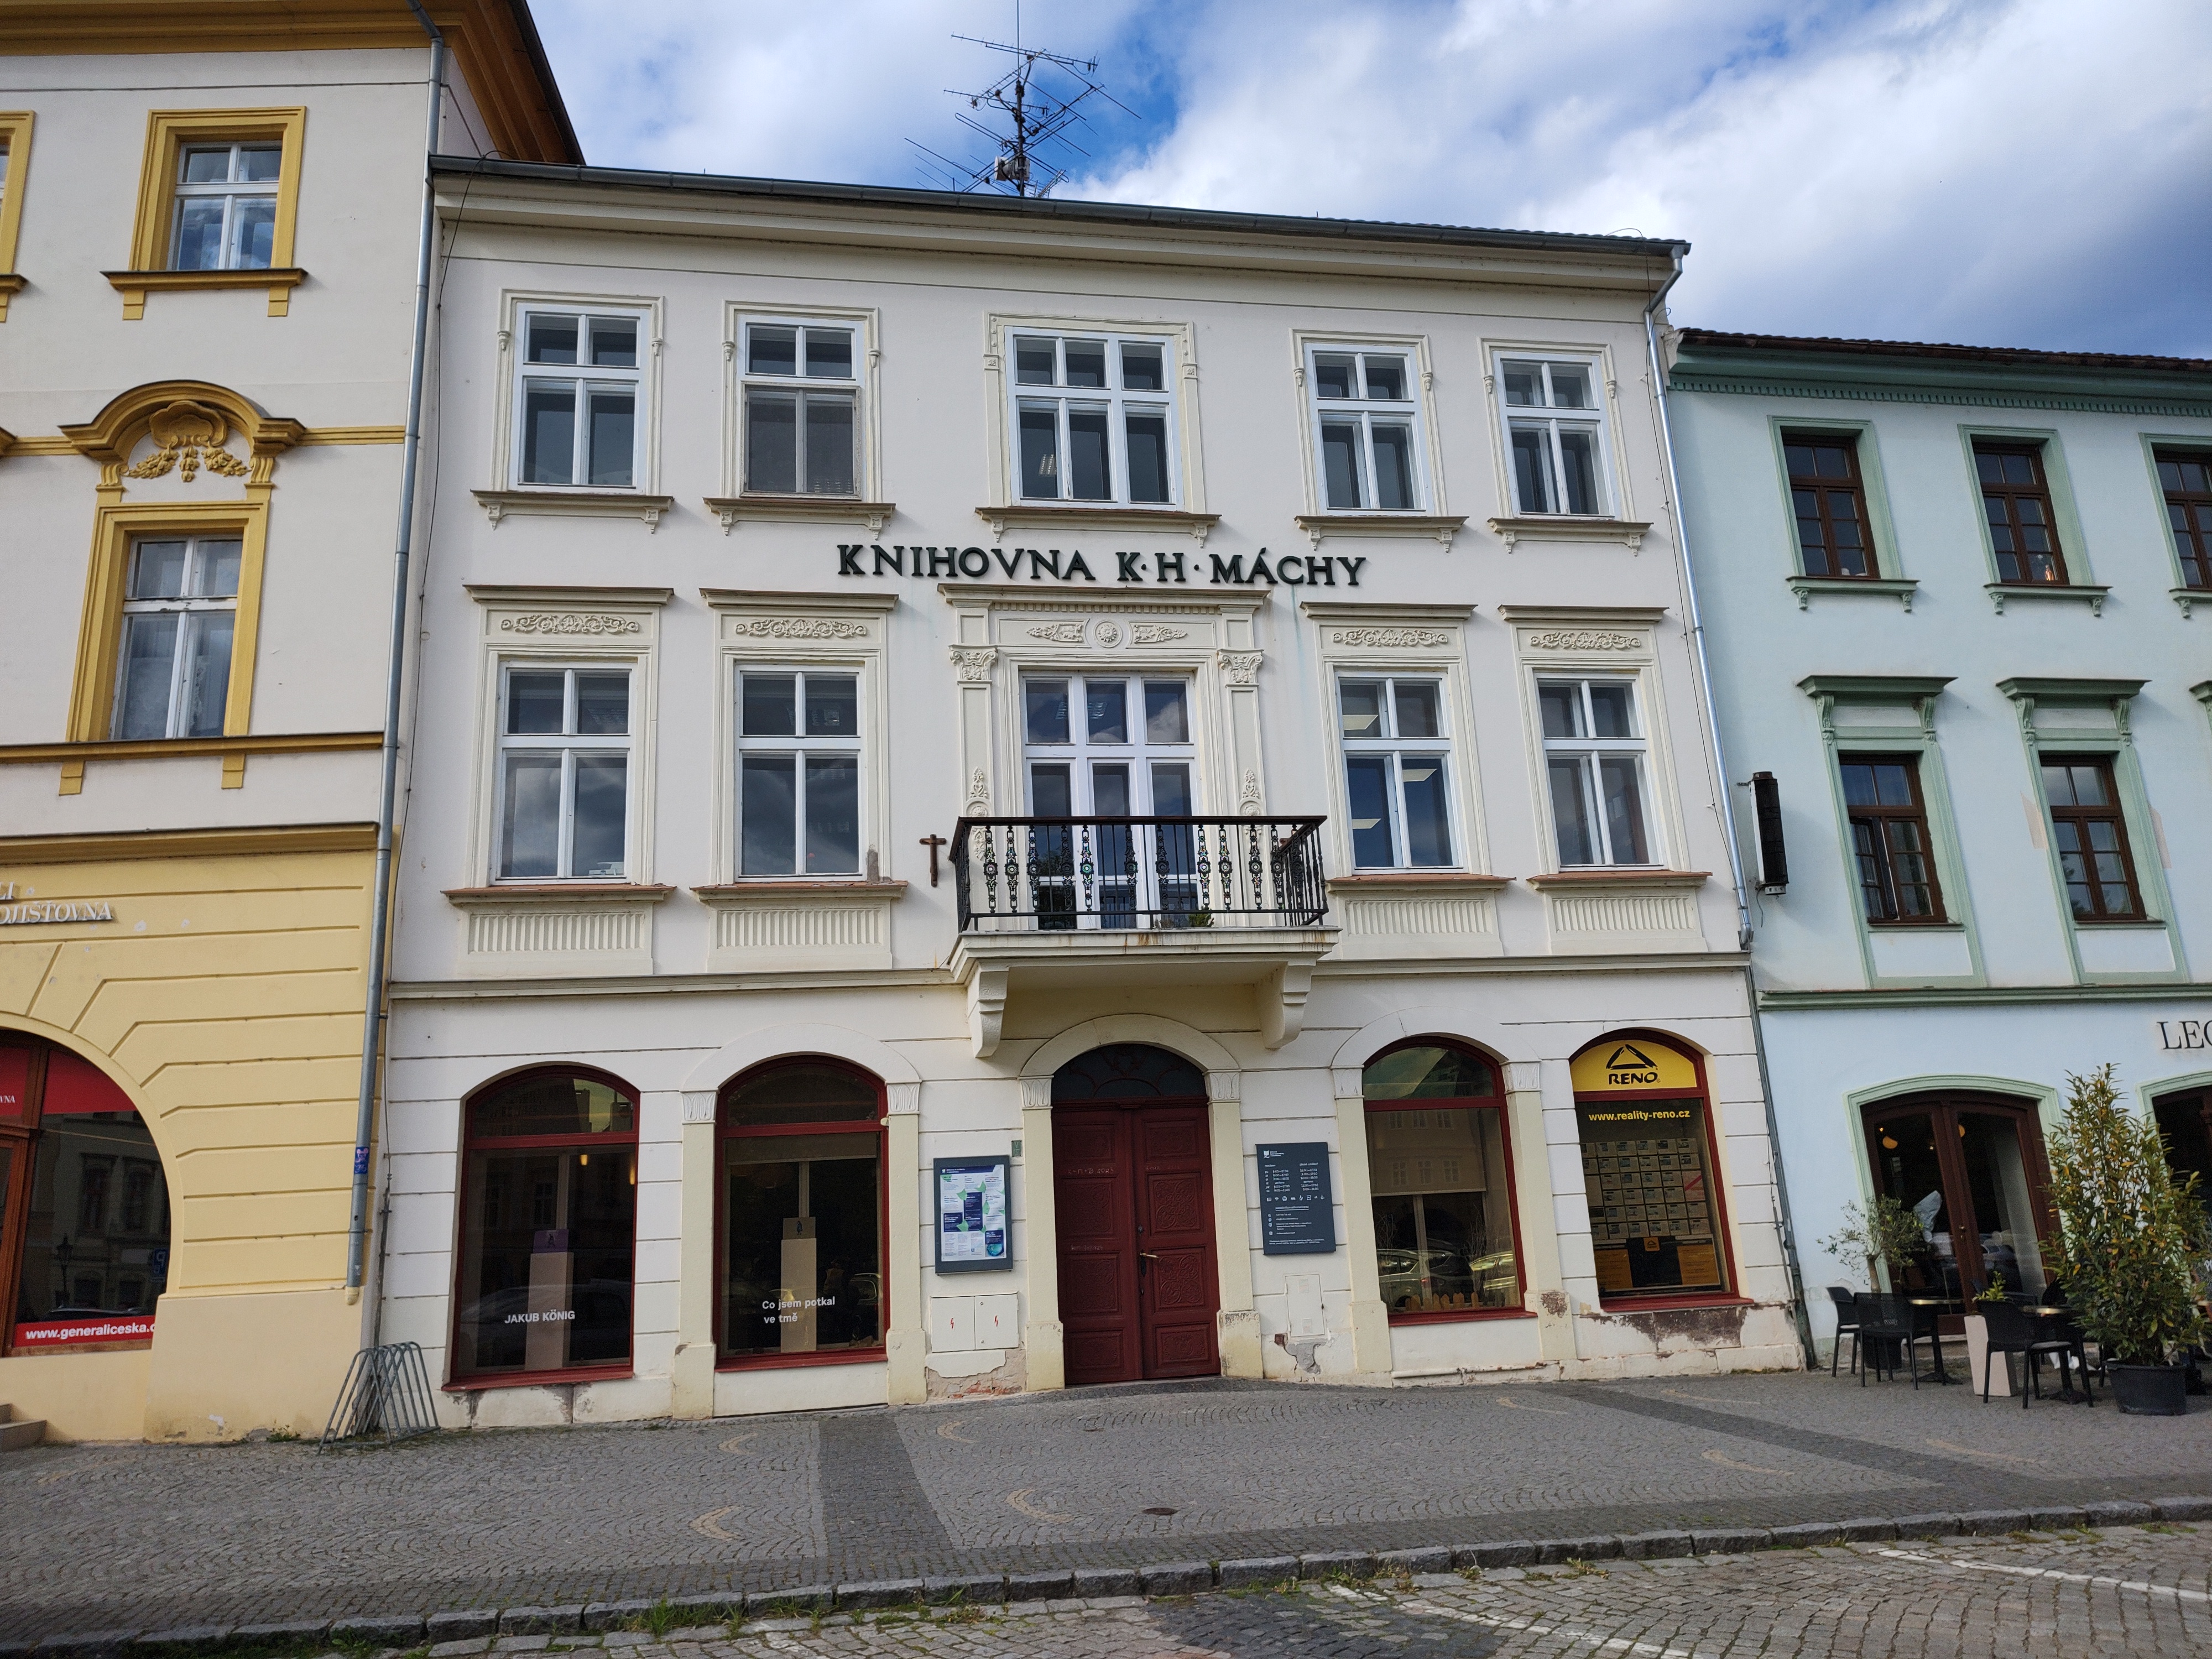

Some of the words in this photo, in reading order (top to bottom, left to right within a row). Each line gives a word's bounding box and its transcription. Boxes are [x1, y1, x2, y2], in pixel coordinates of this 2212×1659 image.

[836, 543, 1097, 581] KNIHOVNA
[1209, 547, 1366, 586] MÁCHY
[1609, 1072, 1658, 1085] RENO
[1588, 1110, 1691, 1121] www.reality-reno.cz
[762, 1300, 775, 1310] Co
[778, 1299, 801, 1311] jsem
[805, 1296, 835, 1309] potkal
[504, 1312, 539, 1323] JAKUB
[542, 1309, 575, 1322] KÖNIG
[779, 1312, 798, 1323] tmě
